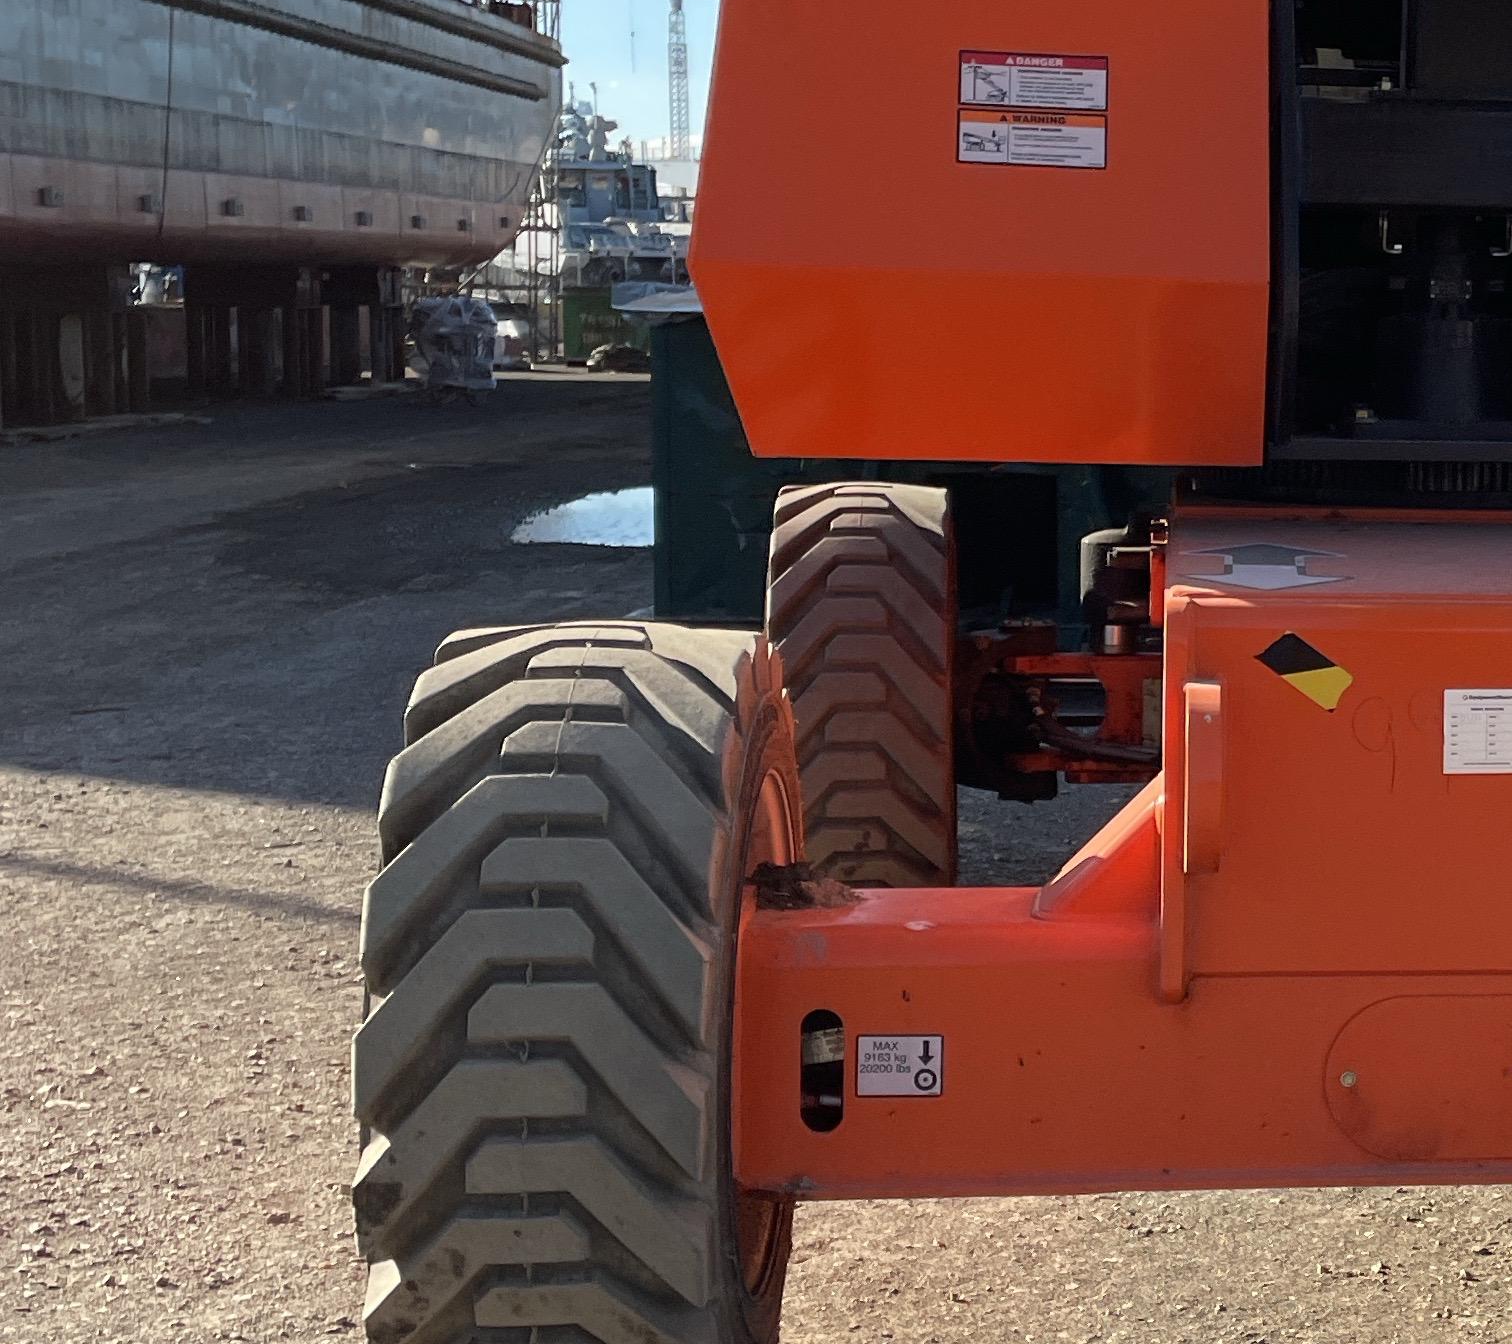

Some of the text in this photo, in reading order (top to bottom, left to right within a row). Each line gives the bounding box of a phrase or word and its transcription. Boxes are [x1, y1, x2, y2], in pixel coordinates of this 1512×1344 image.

[1016, 57, 1064, 67] DANGER
[1012, 114, 1067, 125] WARNING
[873, 1041, 899, 1051] MAX
[894, 1052, 907, 1064] kg
[860, 1063, 911, 1074] 20200 lbs
